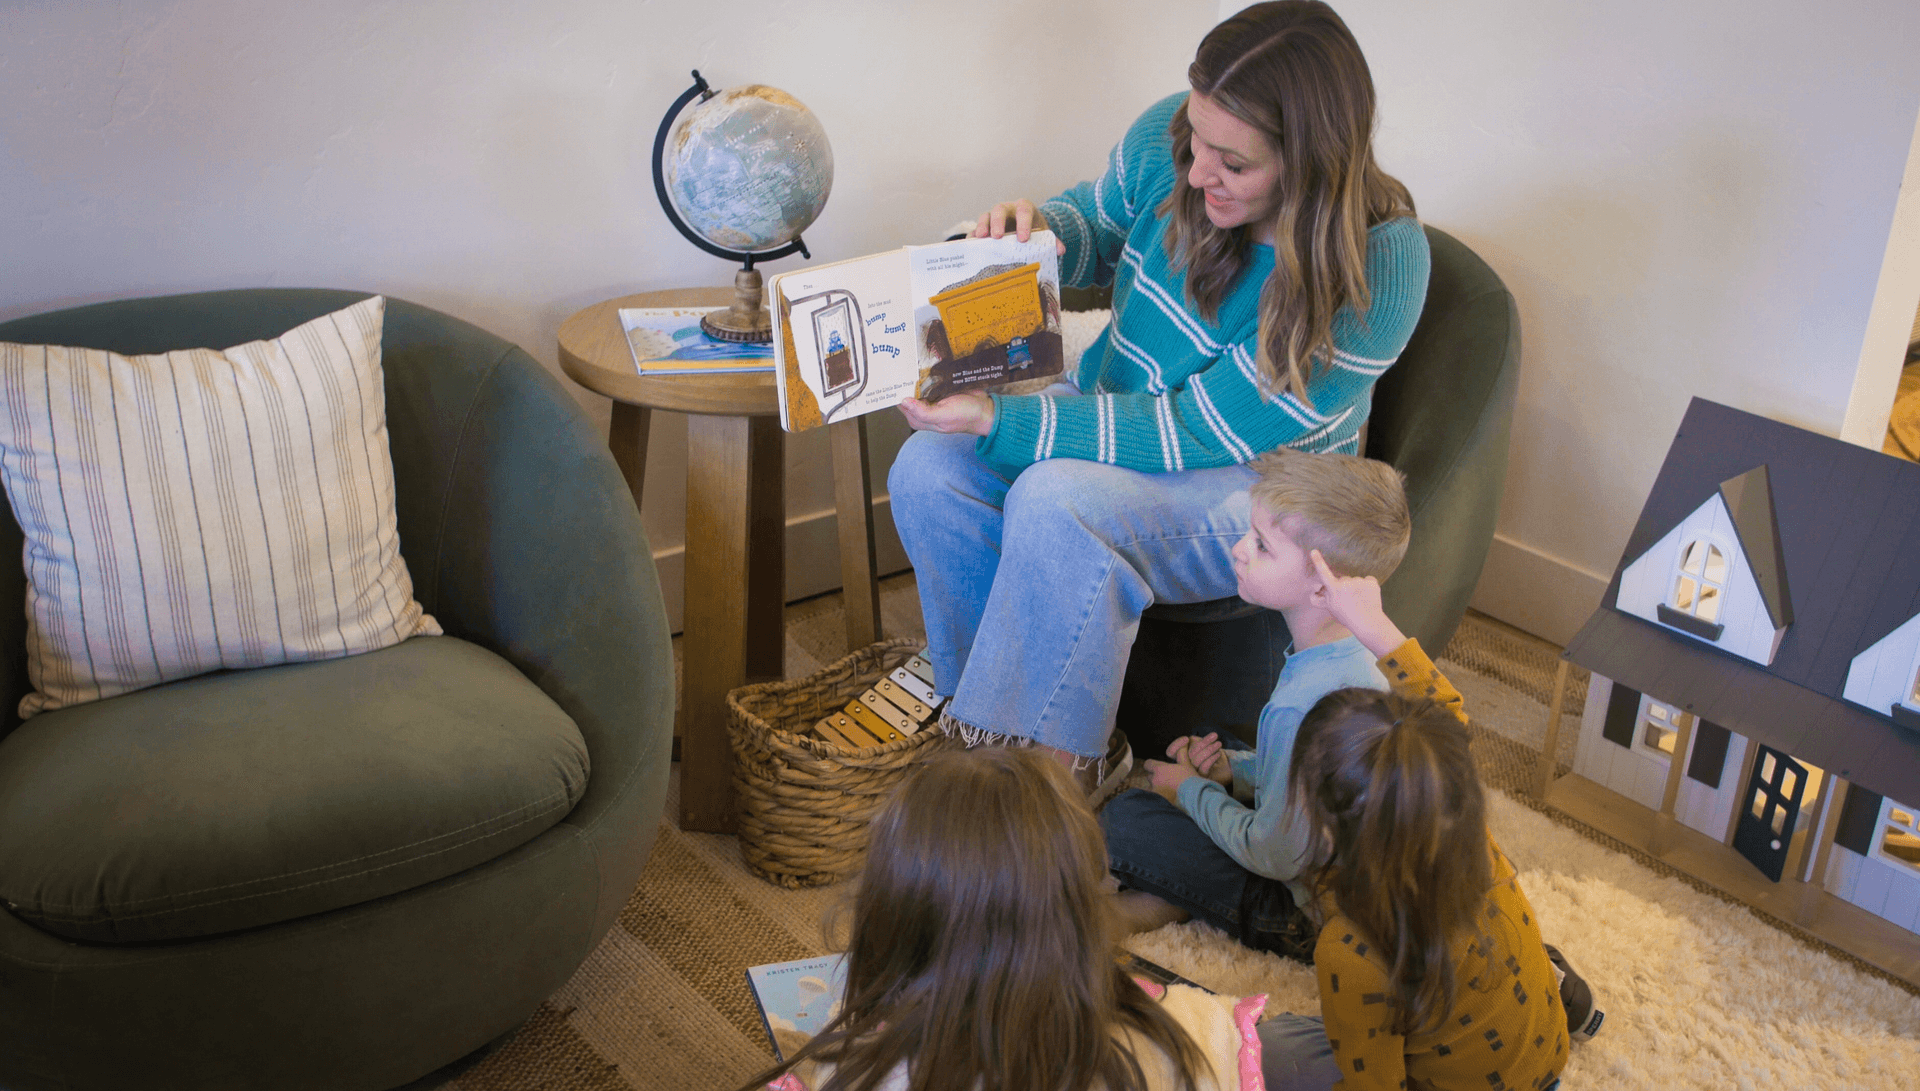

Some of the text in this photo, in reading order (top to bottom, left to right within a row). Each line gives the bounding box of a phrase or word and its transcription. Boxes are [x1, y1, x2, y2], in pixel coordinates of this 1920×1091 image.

[865, 312, 886, 327] bump
[884, 322, 906, 334] bump
[871, 342, 901, 358] bump
[766, 962, 828, 976] KRISTEN TRACY
